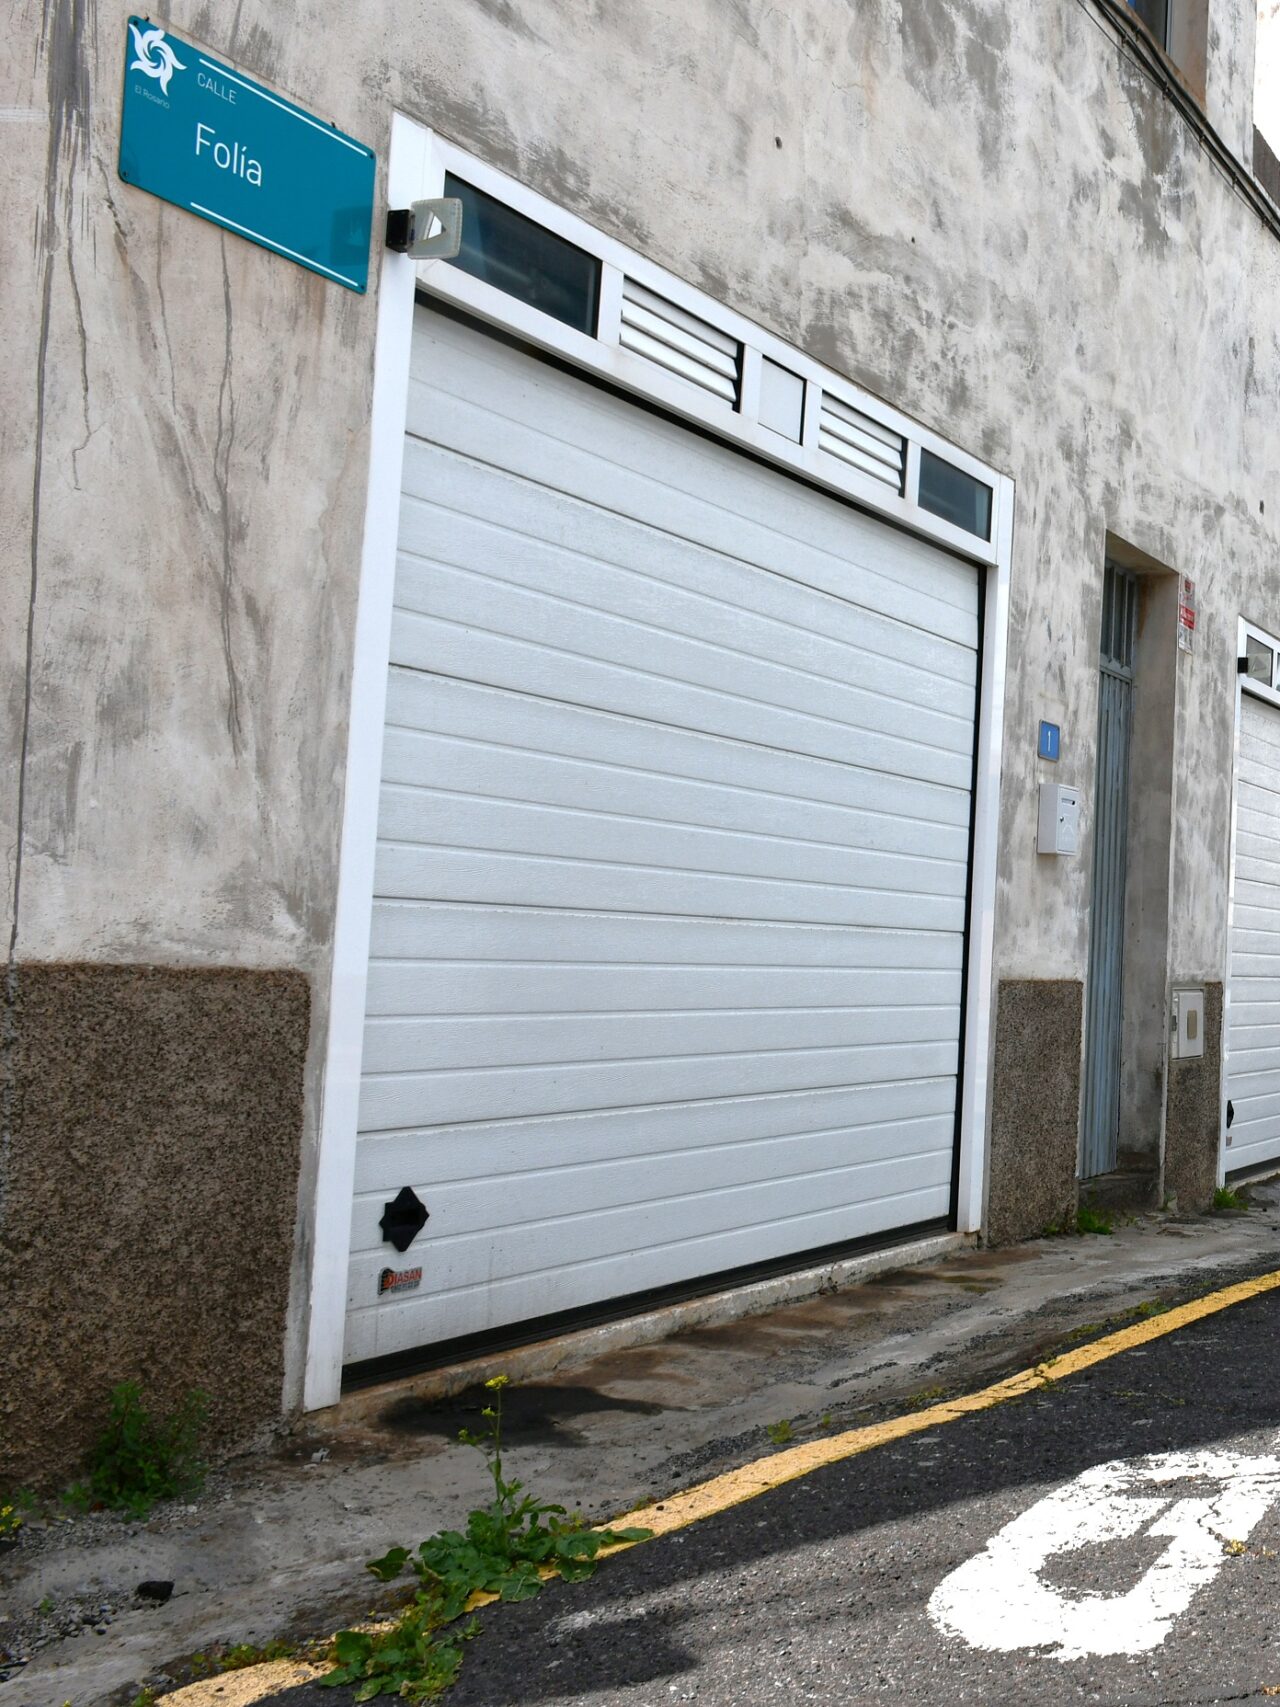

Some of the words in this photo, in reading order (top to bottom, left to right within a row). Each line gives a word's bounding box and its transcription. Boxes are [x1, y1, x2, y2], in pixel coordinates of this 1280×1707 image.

[143, 88, 171, 109] Rosario
[197, 72, 237, 105] CALLE
[195, 122, 262, 187] Folía
[383, 1267, 423, 1289] DIASAN
